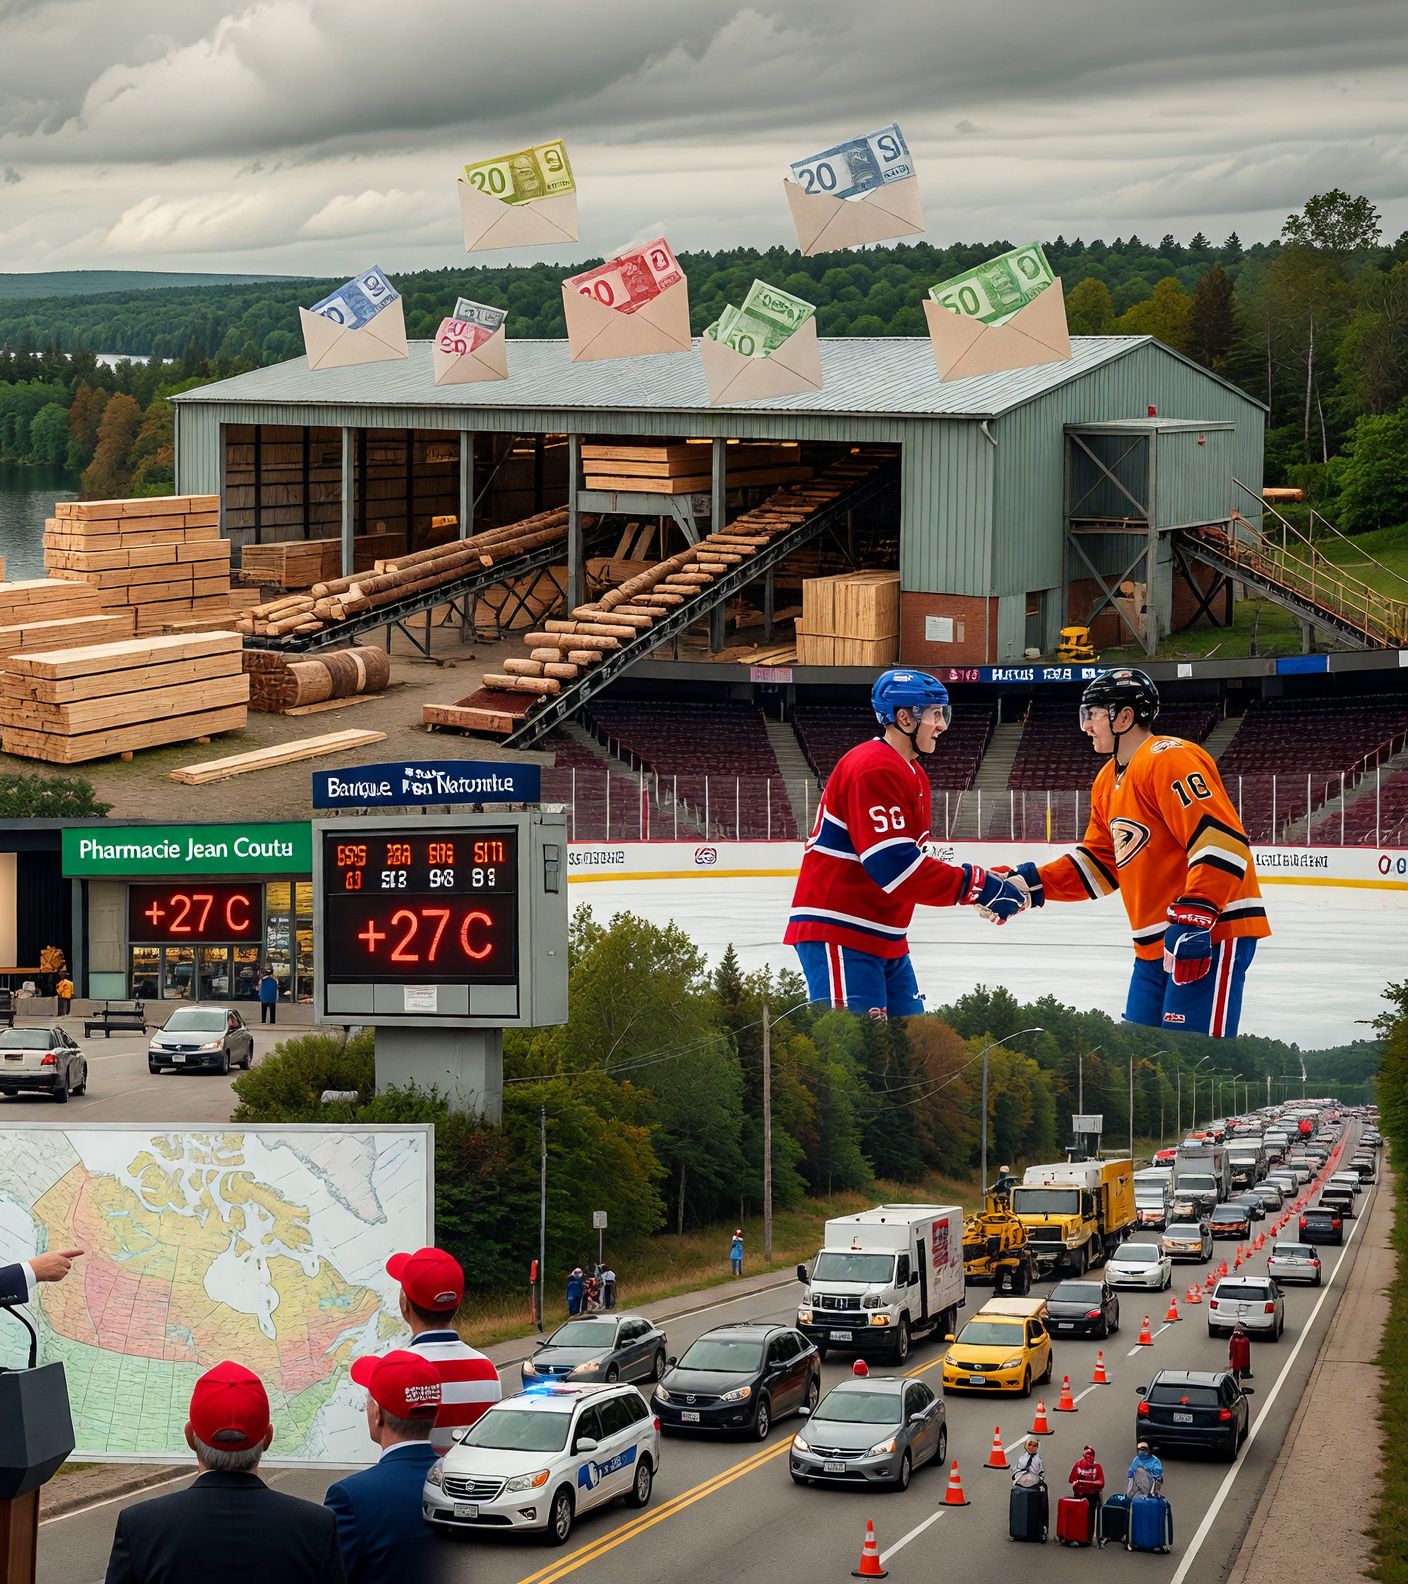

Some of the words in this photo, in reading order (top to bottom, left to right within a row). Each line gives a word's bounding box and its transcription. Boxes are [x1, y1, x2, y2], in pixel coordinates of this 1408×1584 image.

[798, 162, 837, 195] 20
[79, 838, 181, 859] Pharmacie
[185, 837, 228, 861] Jean
